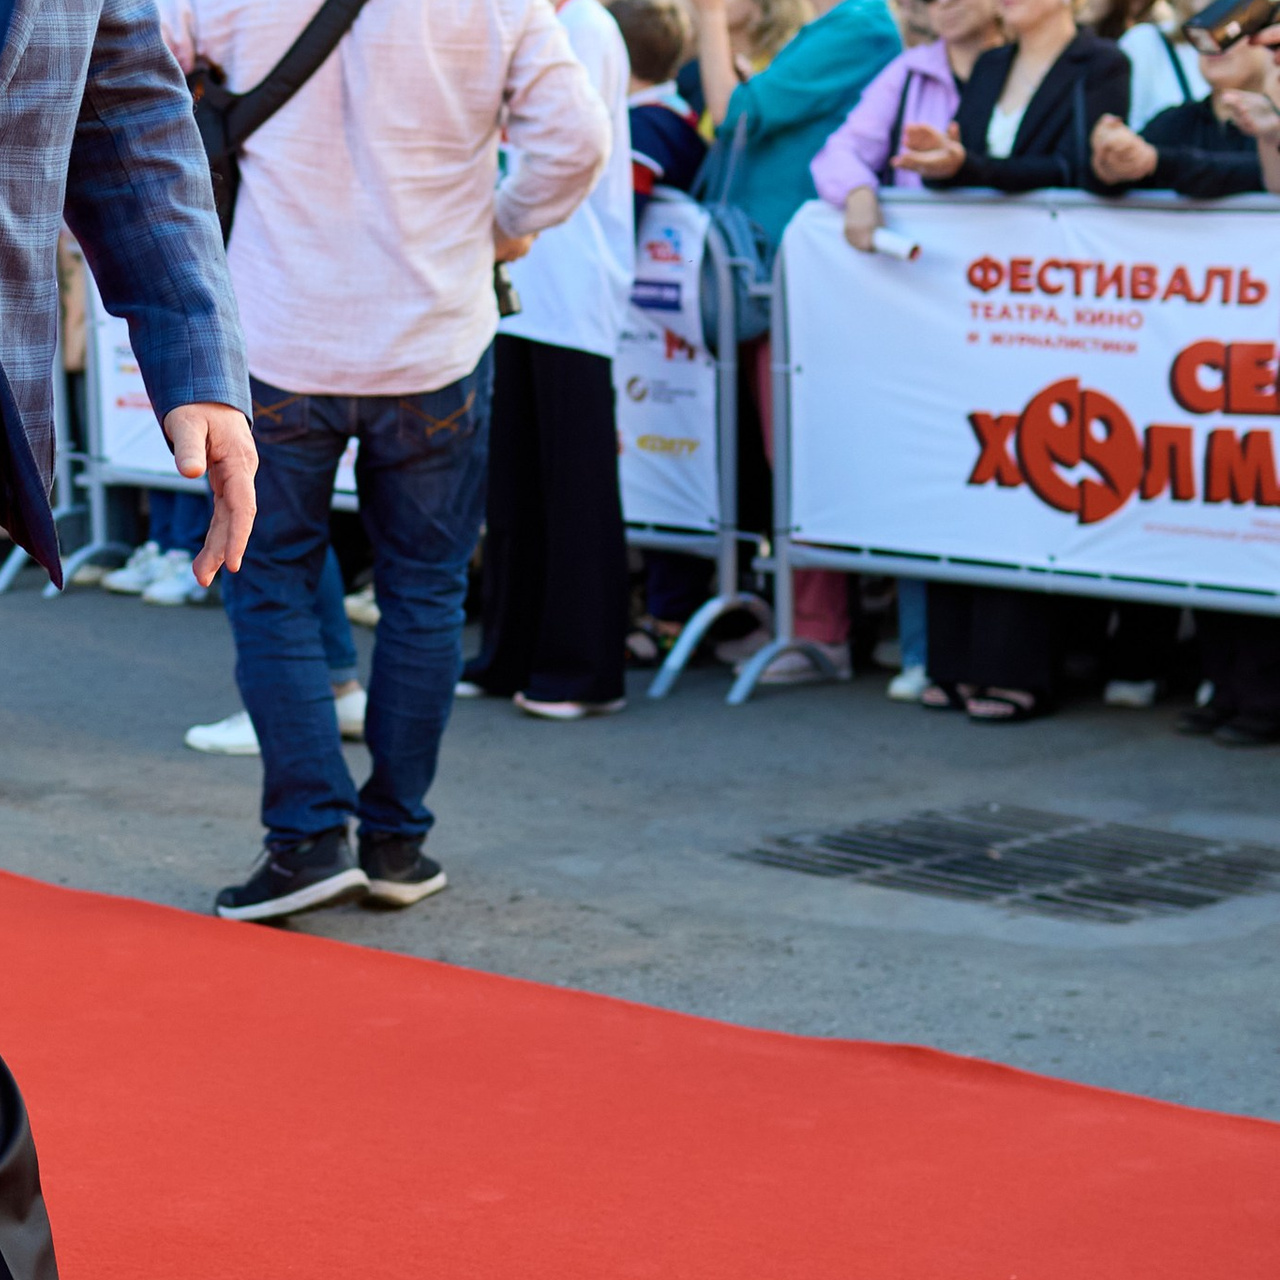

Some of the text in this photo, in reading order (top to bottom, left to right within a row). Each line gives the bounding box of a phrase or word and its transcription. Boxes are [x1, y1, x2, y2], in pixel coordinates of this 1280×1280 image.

[967, 255, 1268, 305] ФЕСТИВАЛЬ
[969, 301, 1144, 330] ТЕАТРА, КИНО
[1170, 339, 1280, 415] СЕ
